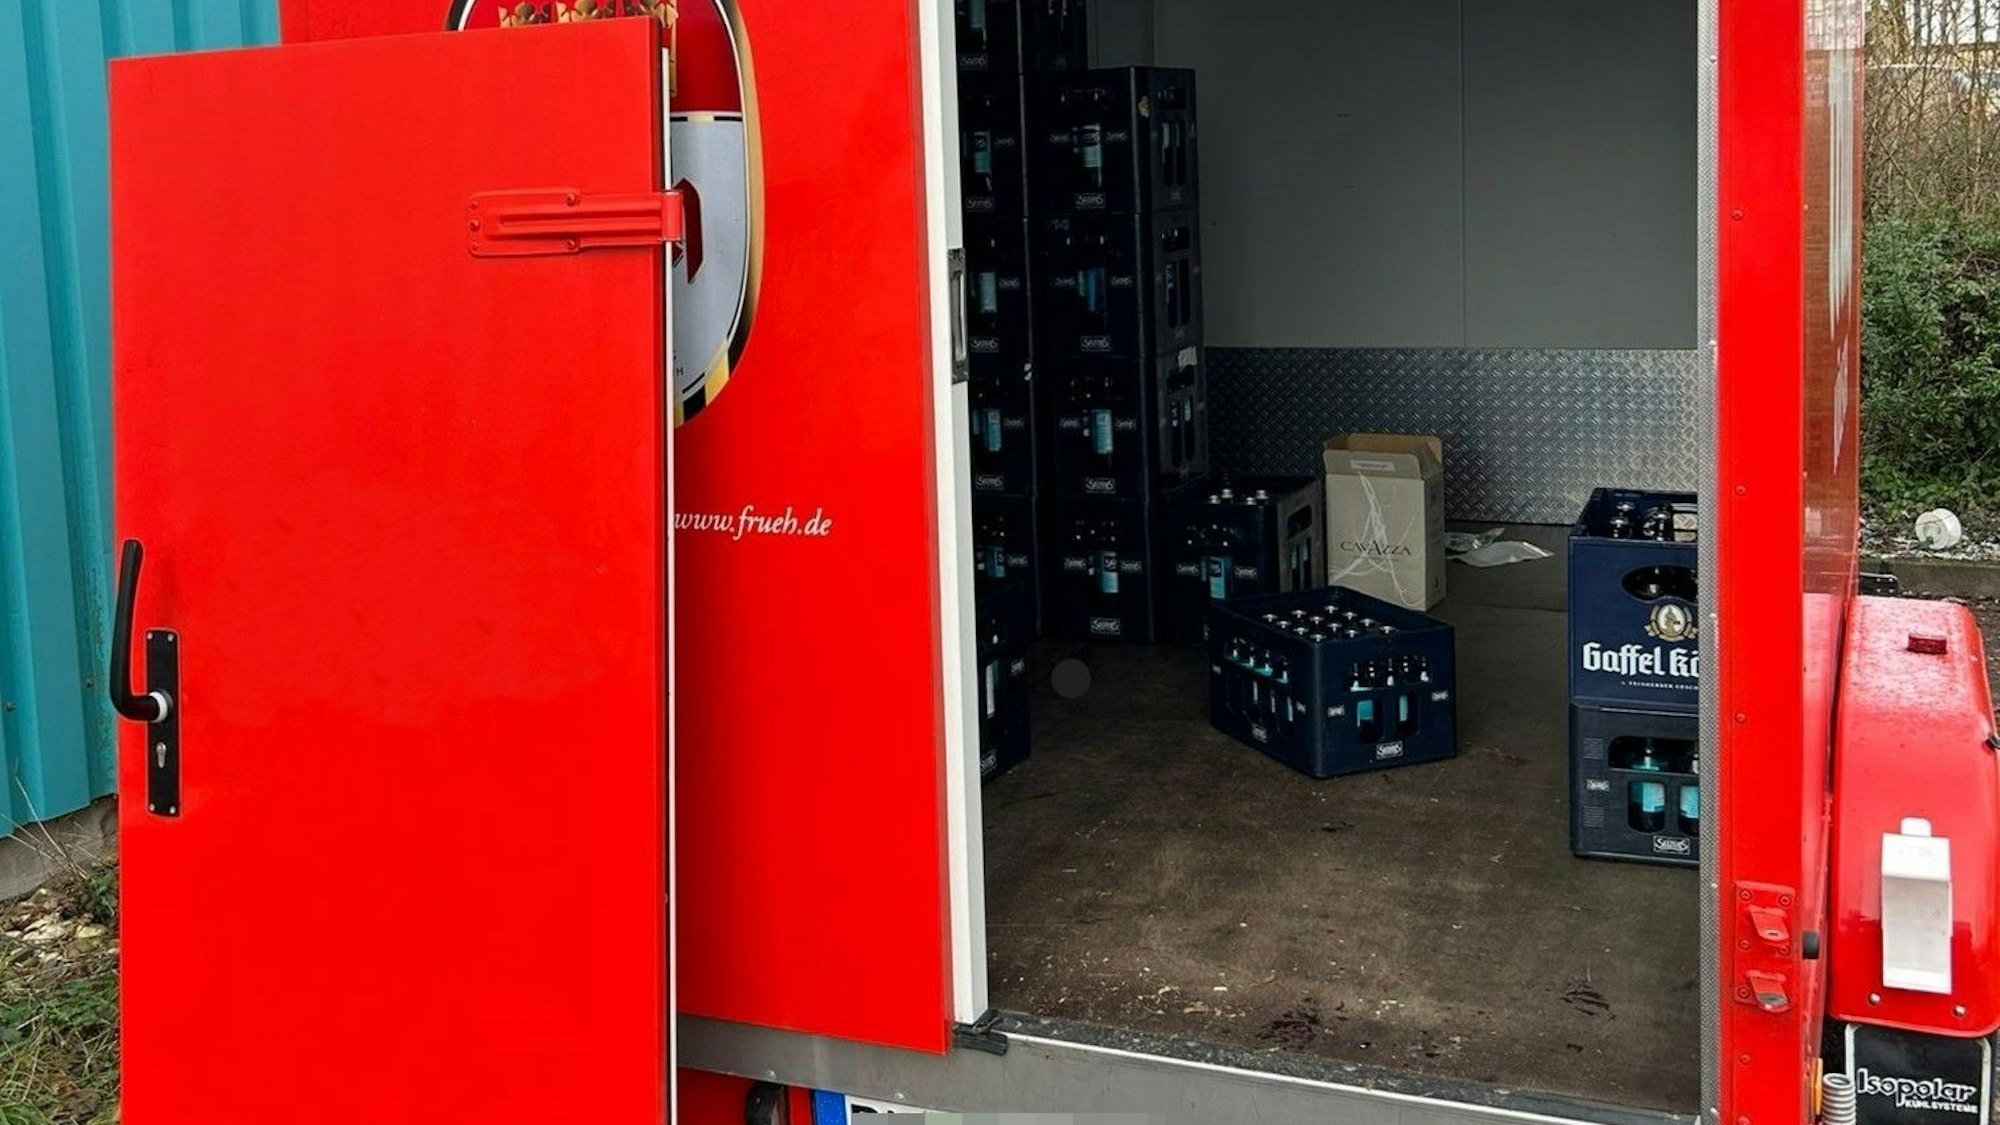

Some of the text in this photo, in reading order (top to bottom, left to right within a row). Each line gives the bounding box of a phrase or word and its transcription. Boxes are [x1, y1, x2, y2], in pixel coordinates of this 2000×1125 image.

[674, 505, 832, 541] www.frueh.de
[1582, 641, 1666, 676] Gaffel
[1857, 1067, 1977, 1107] Isopolar
